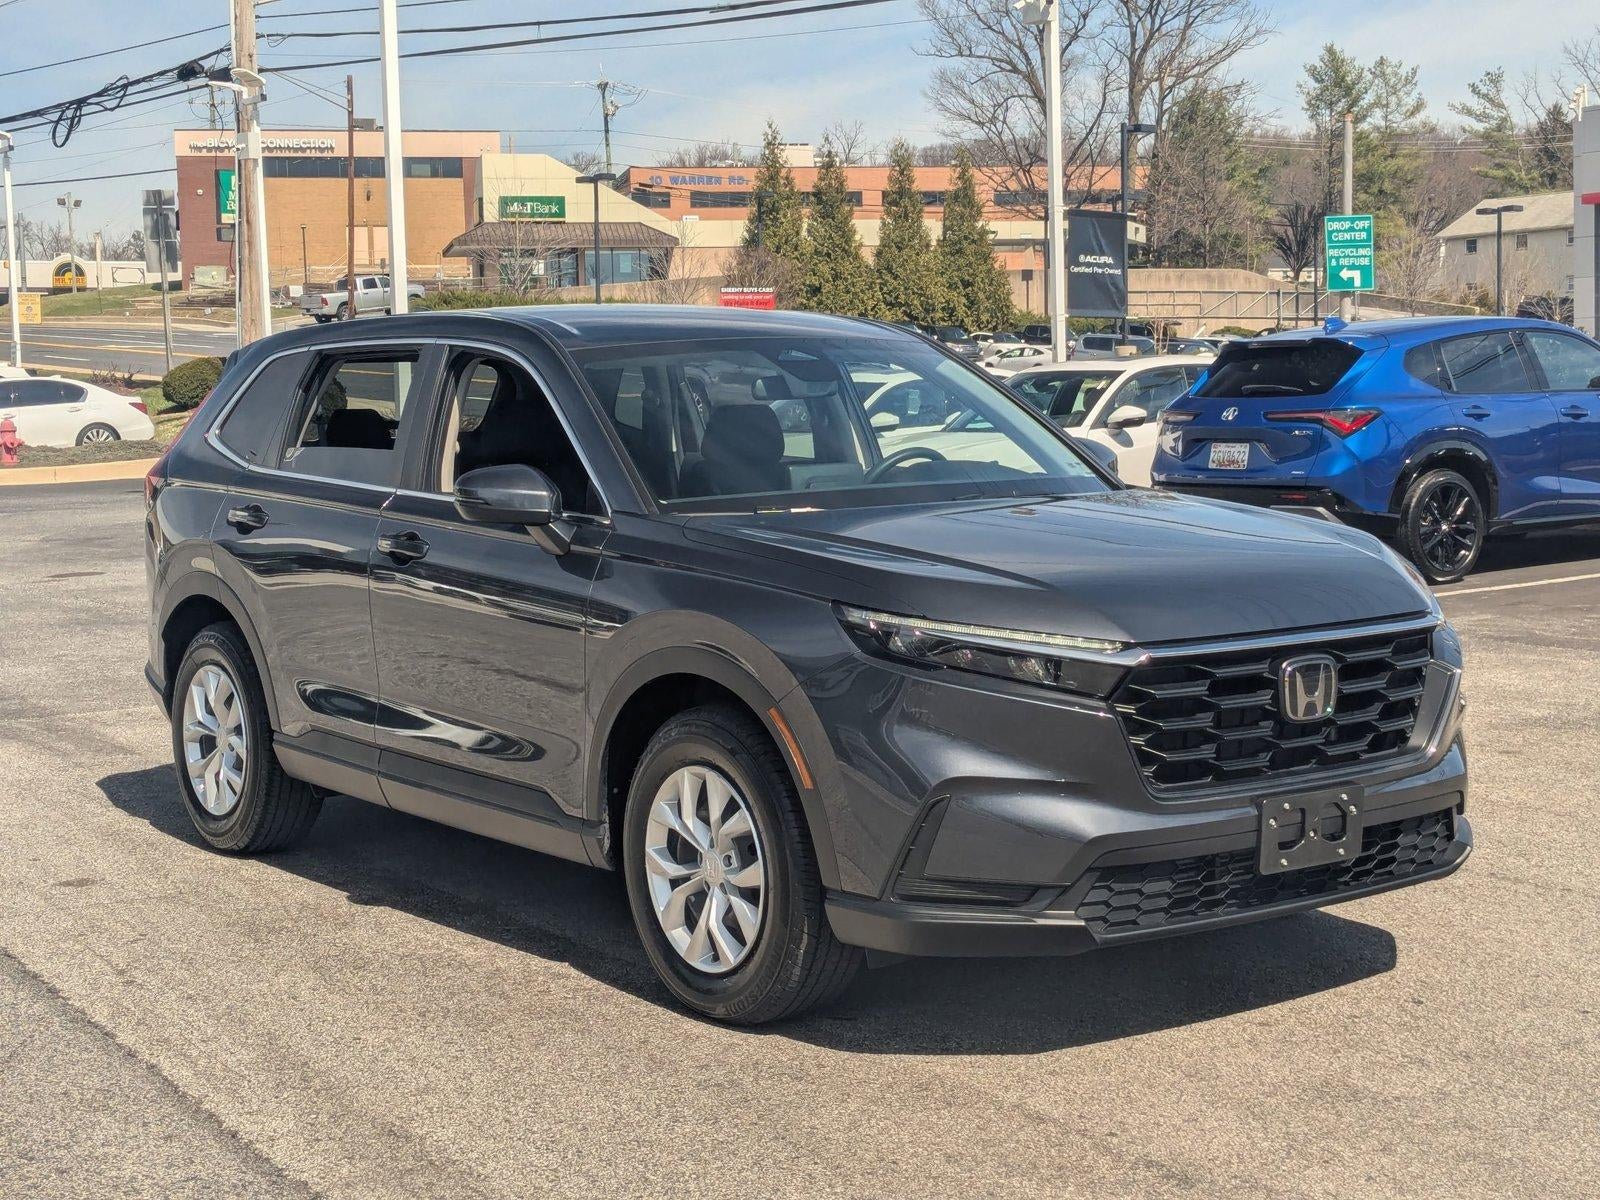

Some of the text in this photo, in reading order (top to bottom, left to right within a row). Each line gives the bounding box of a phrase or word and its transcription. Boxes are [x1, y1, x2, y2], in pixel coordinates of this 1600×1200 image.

[260, 137, 336, 149] CONNECTION
[649, 175, 663, 186] 10
[669, 175, 723, 186] WARREN
[533, 201, 560, 214] Bank
[1327, 220, 1371, 231] DROP-OFF
[1331, 231, 1367, 241] CENTER
[1328, 247, 1371, 257] RECYCLING
[1085, 255, 1114, 264] ACURA
[1331, 257, 1371, 266] & REFUSE
[1070, 265, 1122, 275] Certified Pre-Owned
